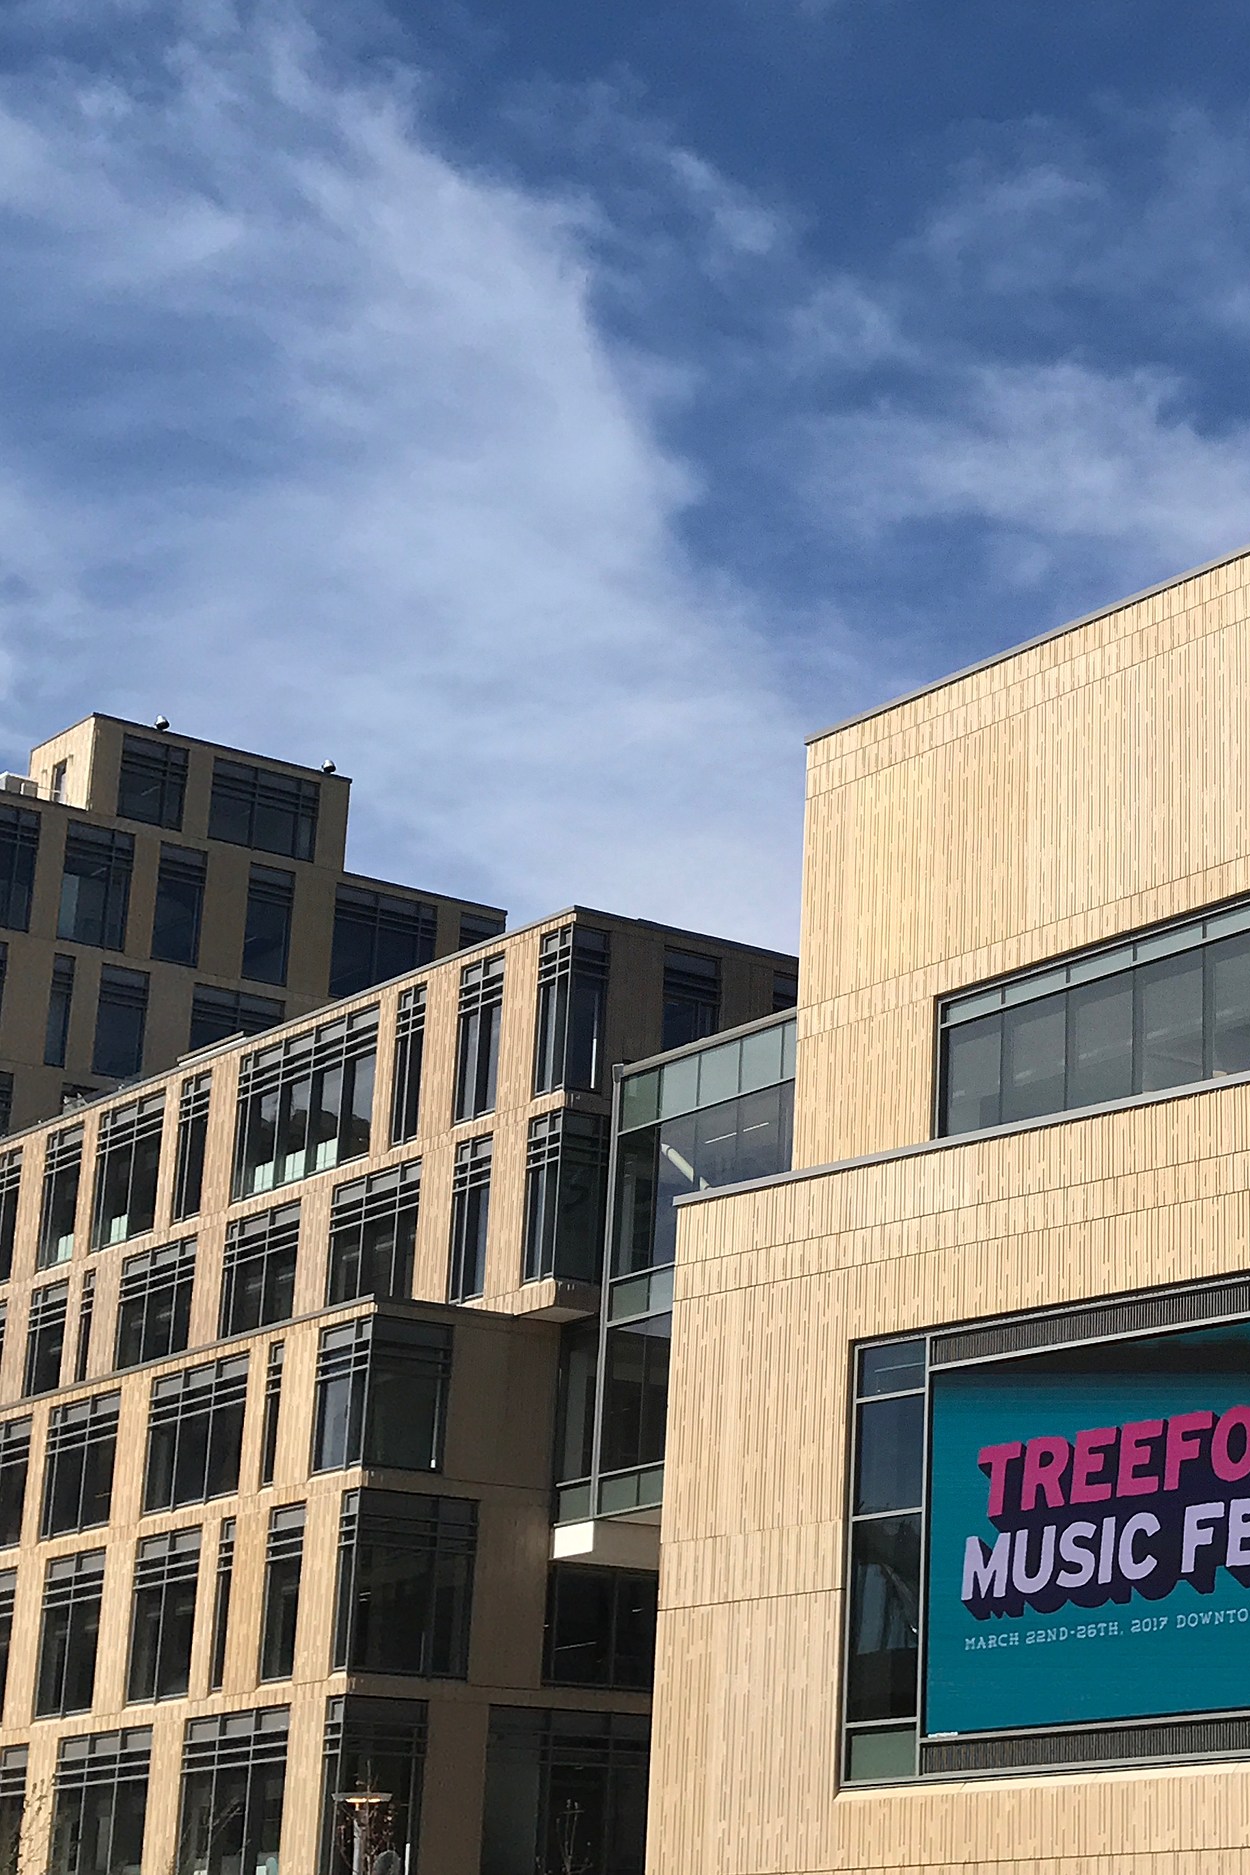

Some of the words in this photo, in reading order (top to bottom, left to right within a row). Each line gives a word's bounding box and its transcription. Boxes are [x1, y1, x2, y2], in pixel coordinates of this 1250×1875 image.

[961, 1512, 1160, 1601] MUSIC
[964, 1633, 1019, 1651] MARCH
[1025, 1621, 1123, 1644] 22ND-26TH,
[1130, 1616, 1170, 1634] 2017
